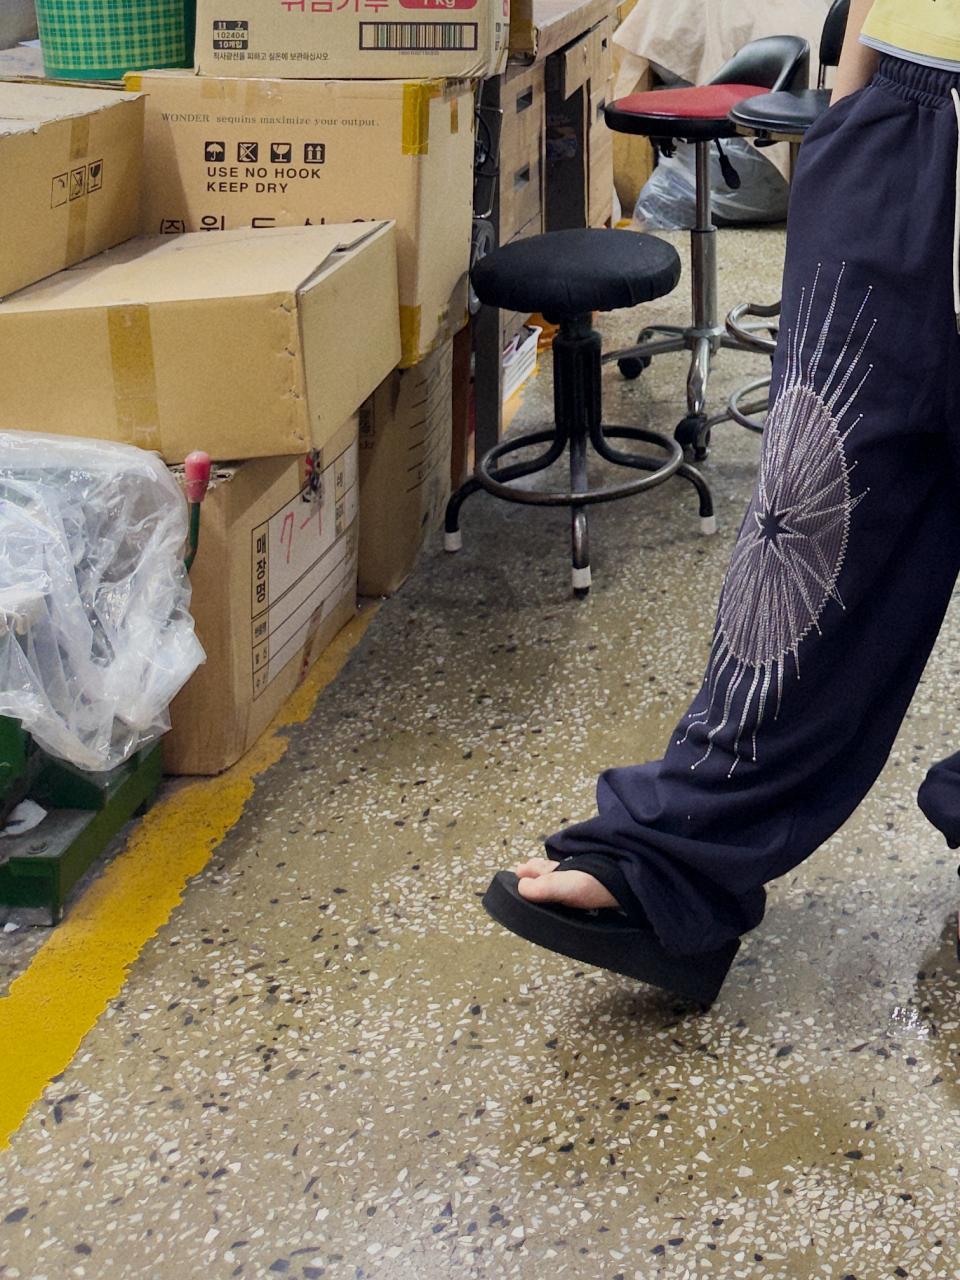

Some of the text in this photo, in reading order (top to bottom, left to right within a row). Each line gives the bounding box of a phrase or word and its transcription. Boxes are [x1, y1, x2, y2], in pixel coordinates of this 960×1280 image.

[161, 113, 210, 123] WONDER
[216, 114, 256, 125] sequins
[260, 115, 310, 125] maximize
[314, 118, 338, 127] your
[207, 166, 322, 180] USE NO HOOK
[206, 182, 288, 194] KEEP DRY
